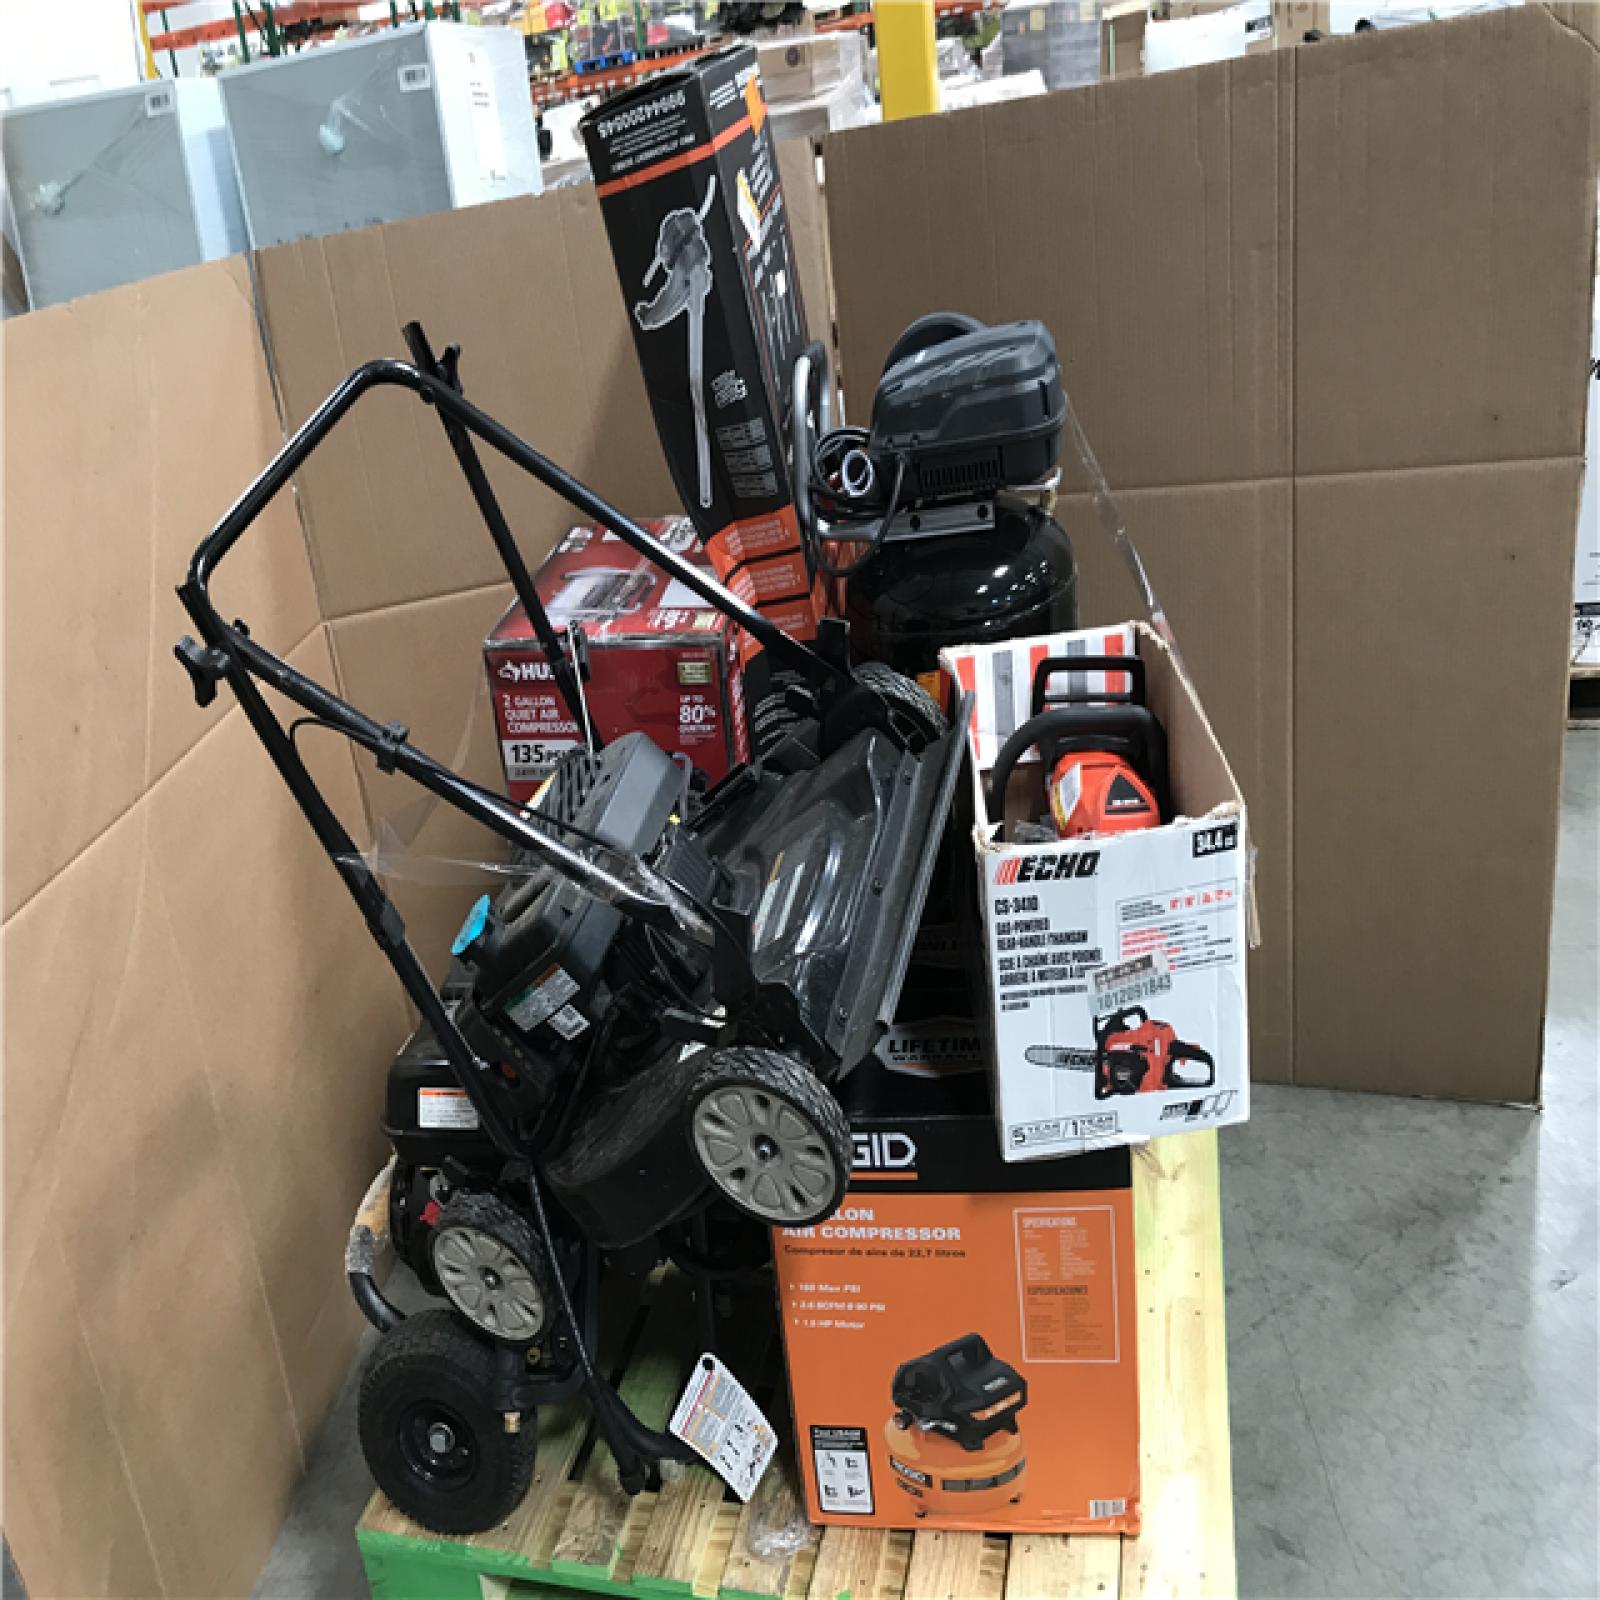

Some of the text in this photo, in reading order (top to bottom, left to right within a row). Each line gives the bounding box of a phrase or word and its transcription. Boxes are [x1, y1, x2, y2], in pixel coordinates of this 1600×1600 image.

[679, 704, 716, 723] 80%
[511, 744, 545, 763] 135
[1017, 850, 1100, 882] ECHO
[994, 894, 1039, 915] CS-3410
[889, 1038, 981, 1053] LIFETIM
[1012, 1127, 1026, 1144] 5
[852, 1132, 917, 1168] GID
[829, 1207, 874, 1221] LON
[782, 1226, 961, 1241] AIR COMPRESSOR
